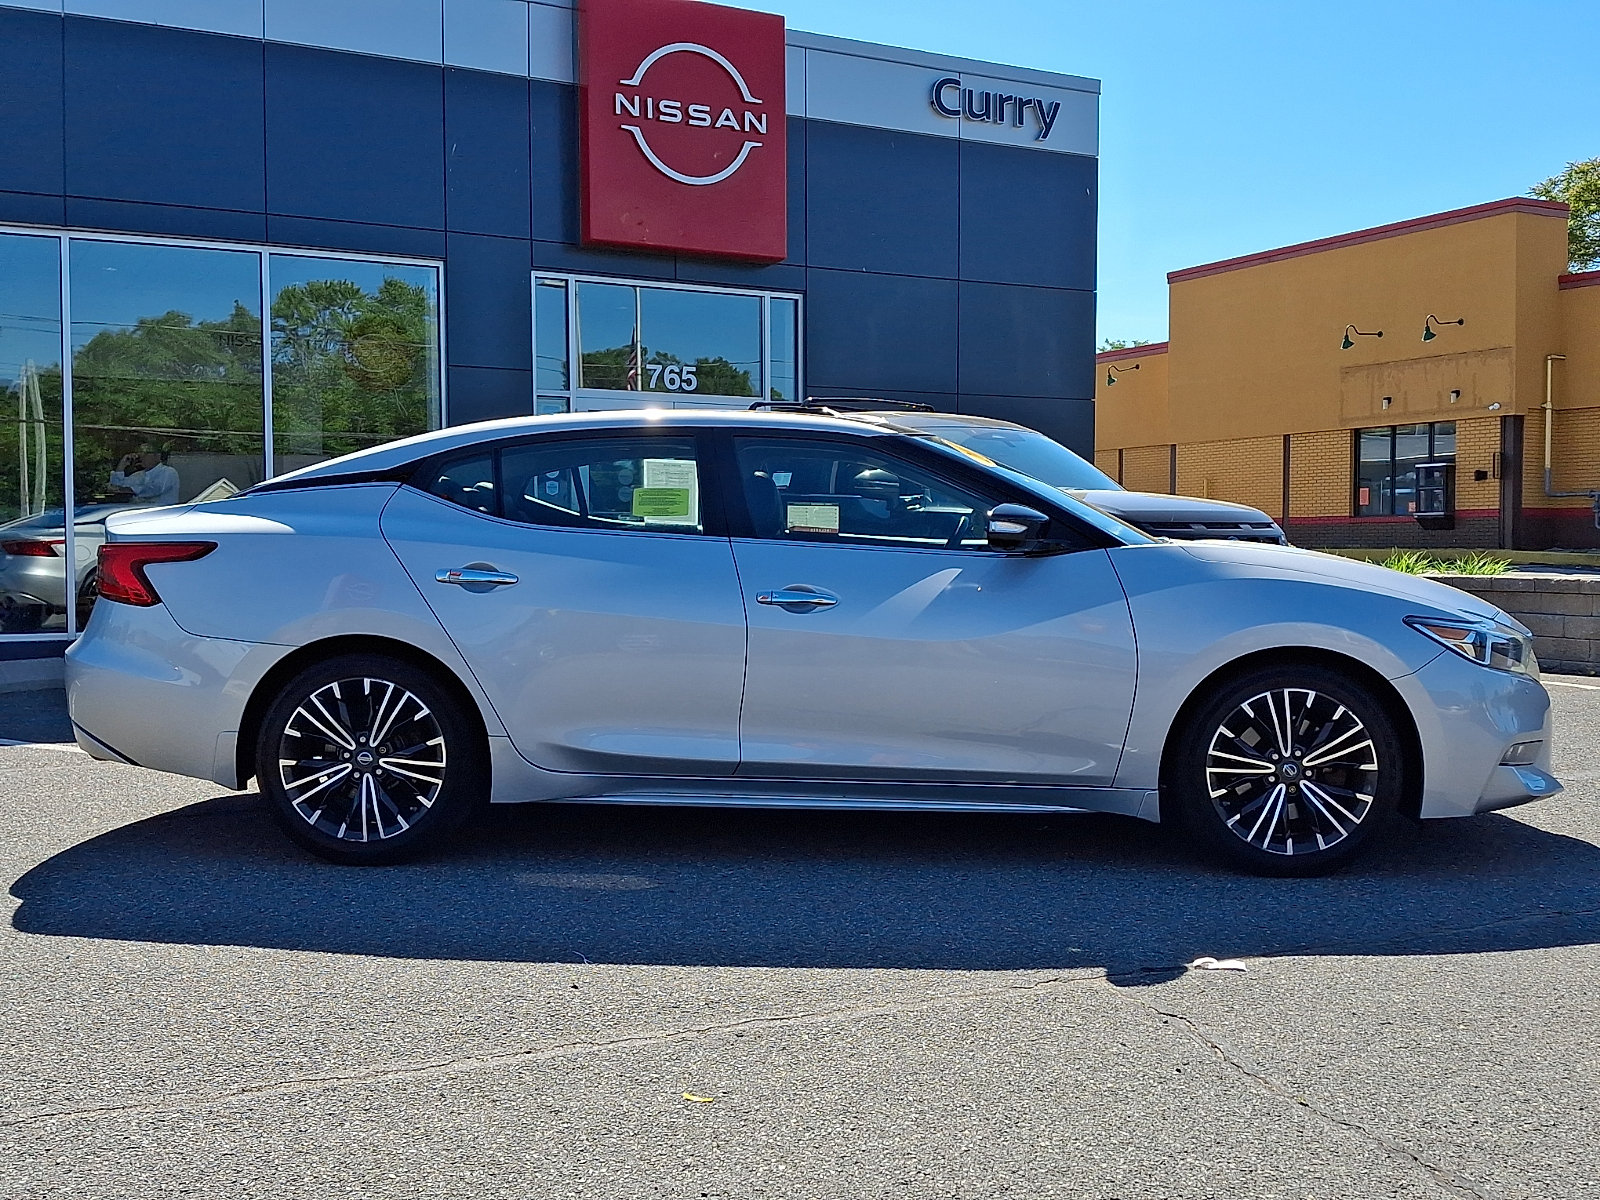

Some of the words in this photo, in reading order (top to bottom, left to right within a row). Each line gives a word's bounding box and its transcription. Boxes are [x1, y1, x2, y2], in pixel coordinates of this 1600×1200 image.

[614, 92, 768, 135] NISSAN
[931, 77, 1062, 141] Curry
[645, 363, 698, 391] 765
